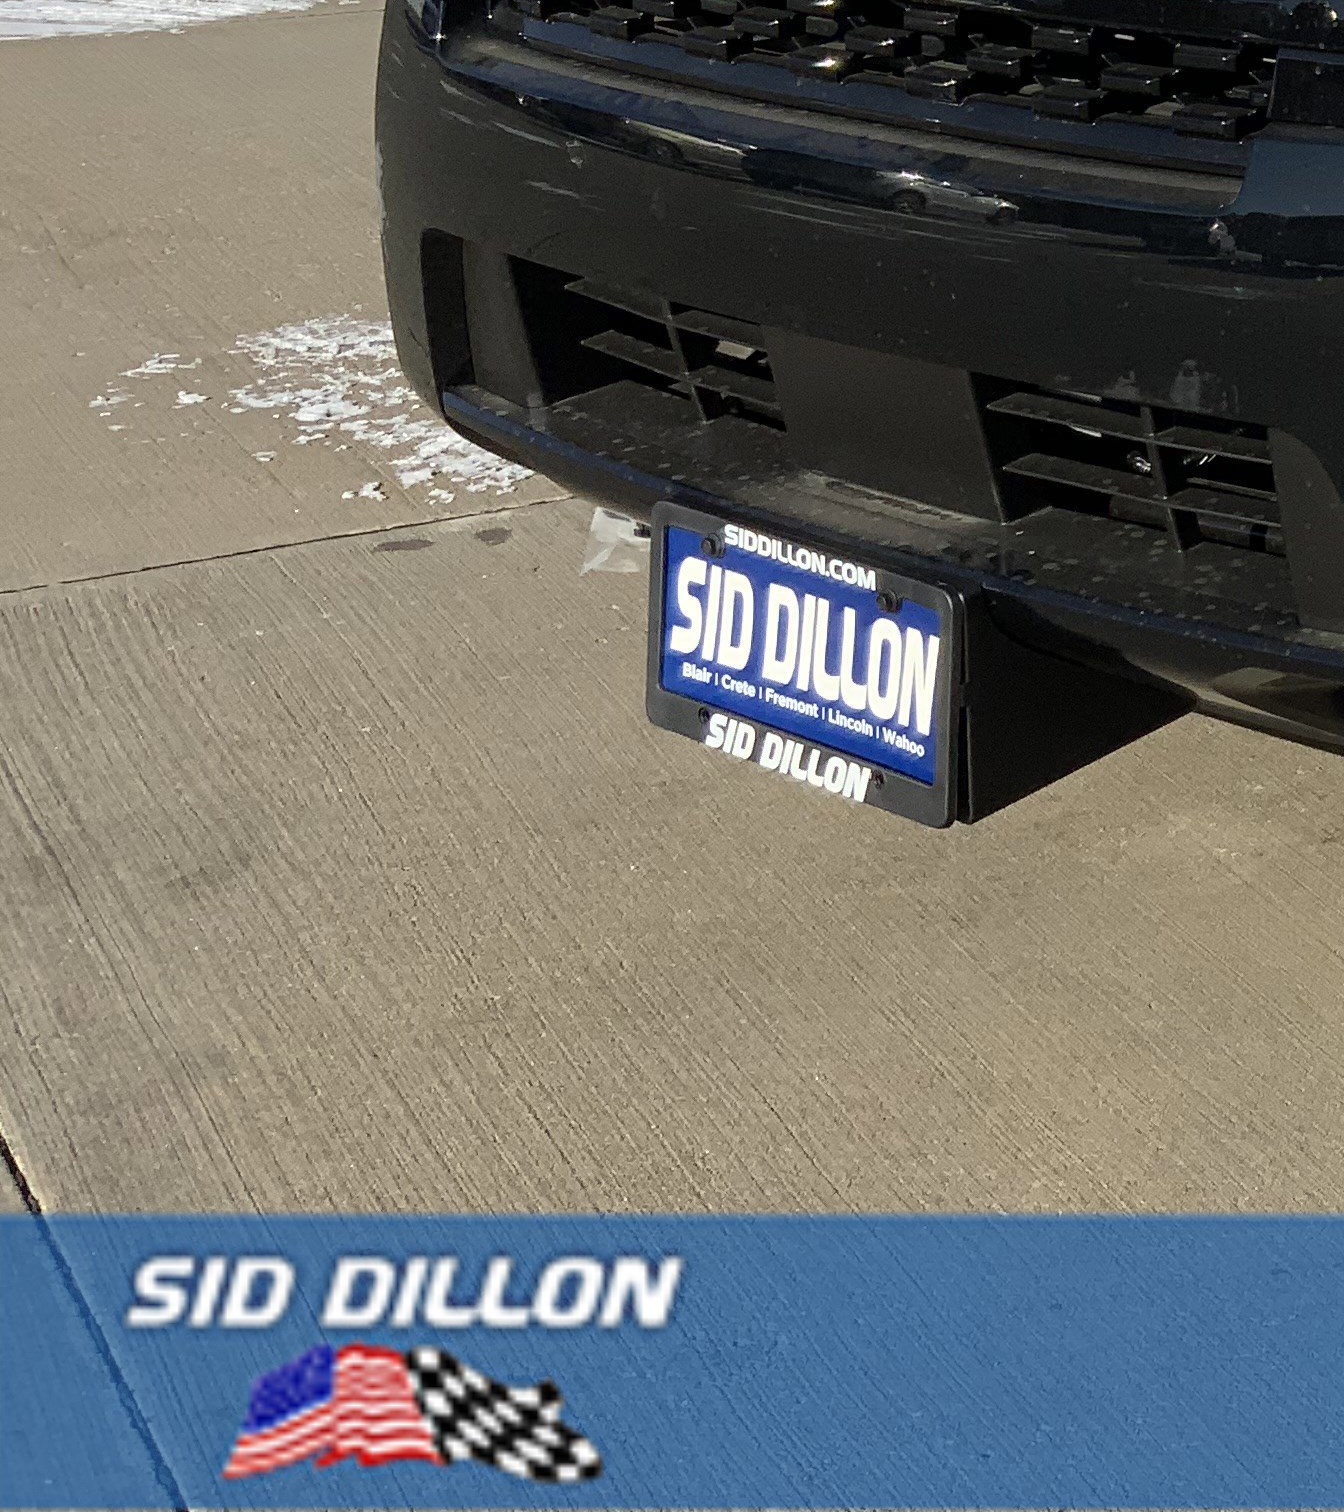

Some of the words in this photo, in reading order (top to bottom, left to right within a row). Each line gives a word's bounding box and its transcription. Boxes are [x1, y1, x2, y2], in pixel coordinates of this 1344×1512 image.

[723, 523, 877, 591] SIDDILLON.COM
[670, 556, 755, 671] SID
[761, 582, 941, 737] DILLON
[682, 661, 713, 686] Blair
[721, 674, 756, 698] Crete
[765, 688, 819, 720] Fremont
[828, 706, 874, 738] Lincoln
[881, 726, 926, 758] Wahoo
[705, 712, 757, 760] SID
[759, 731, 873, 803] DILLON
